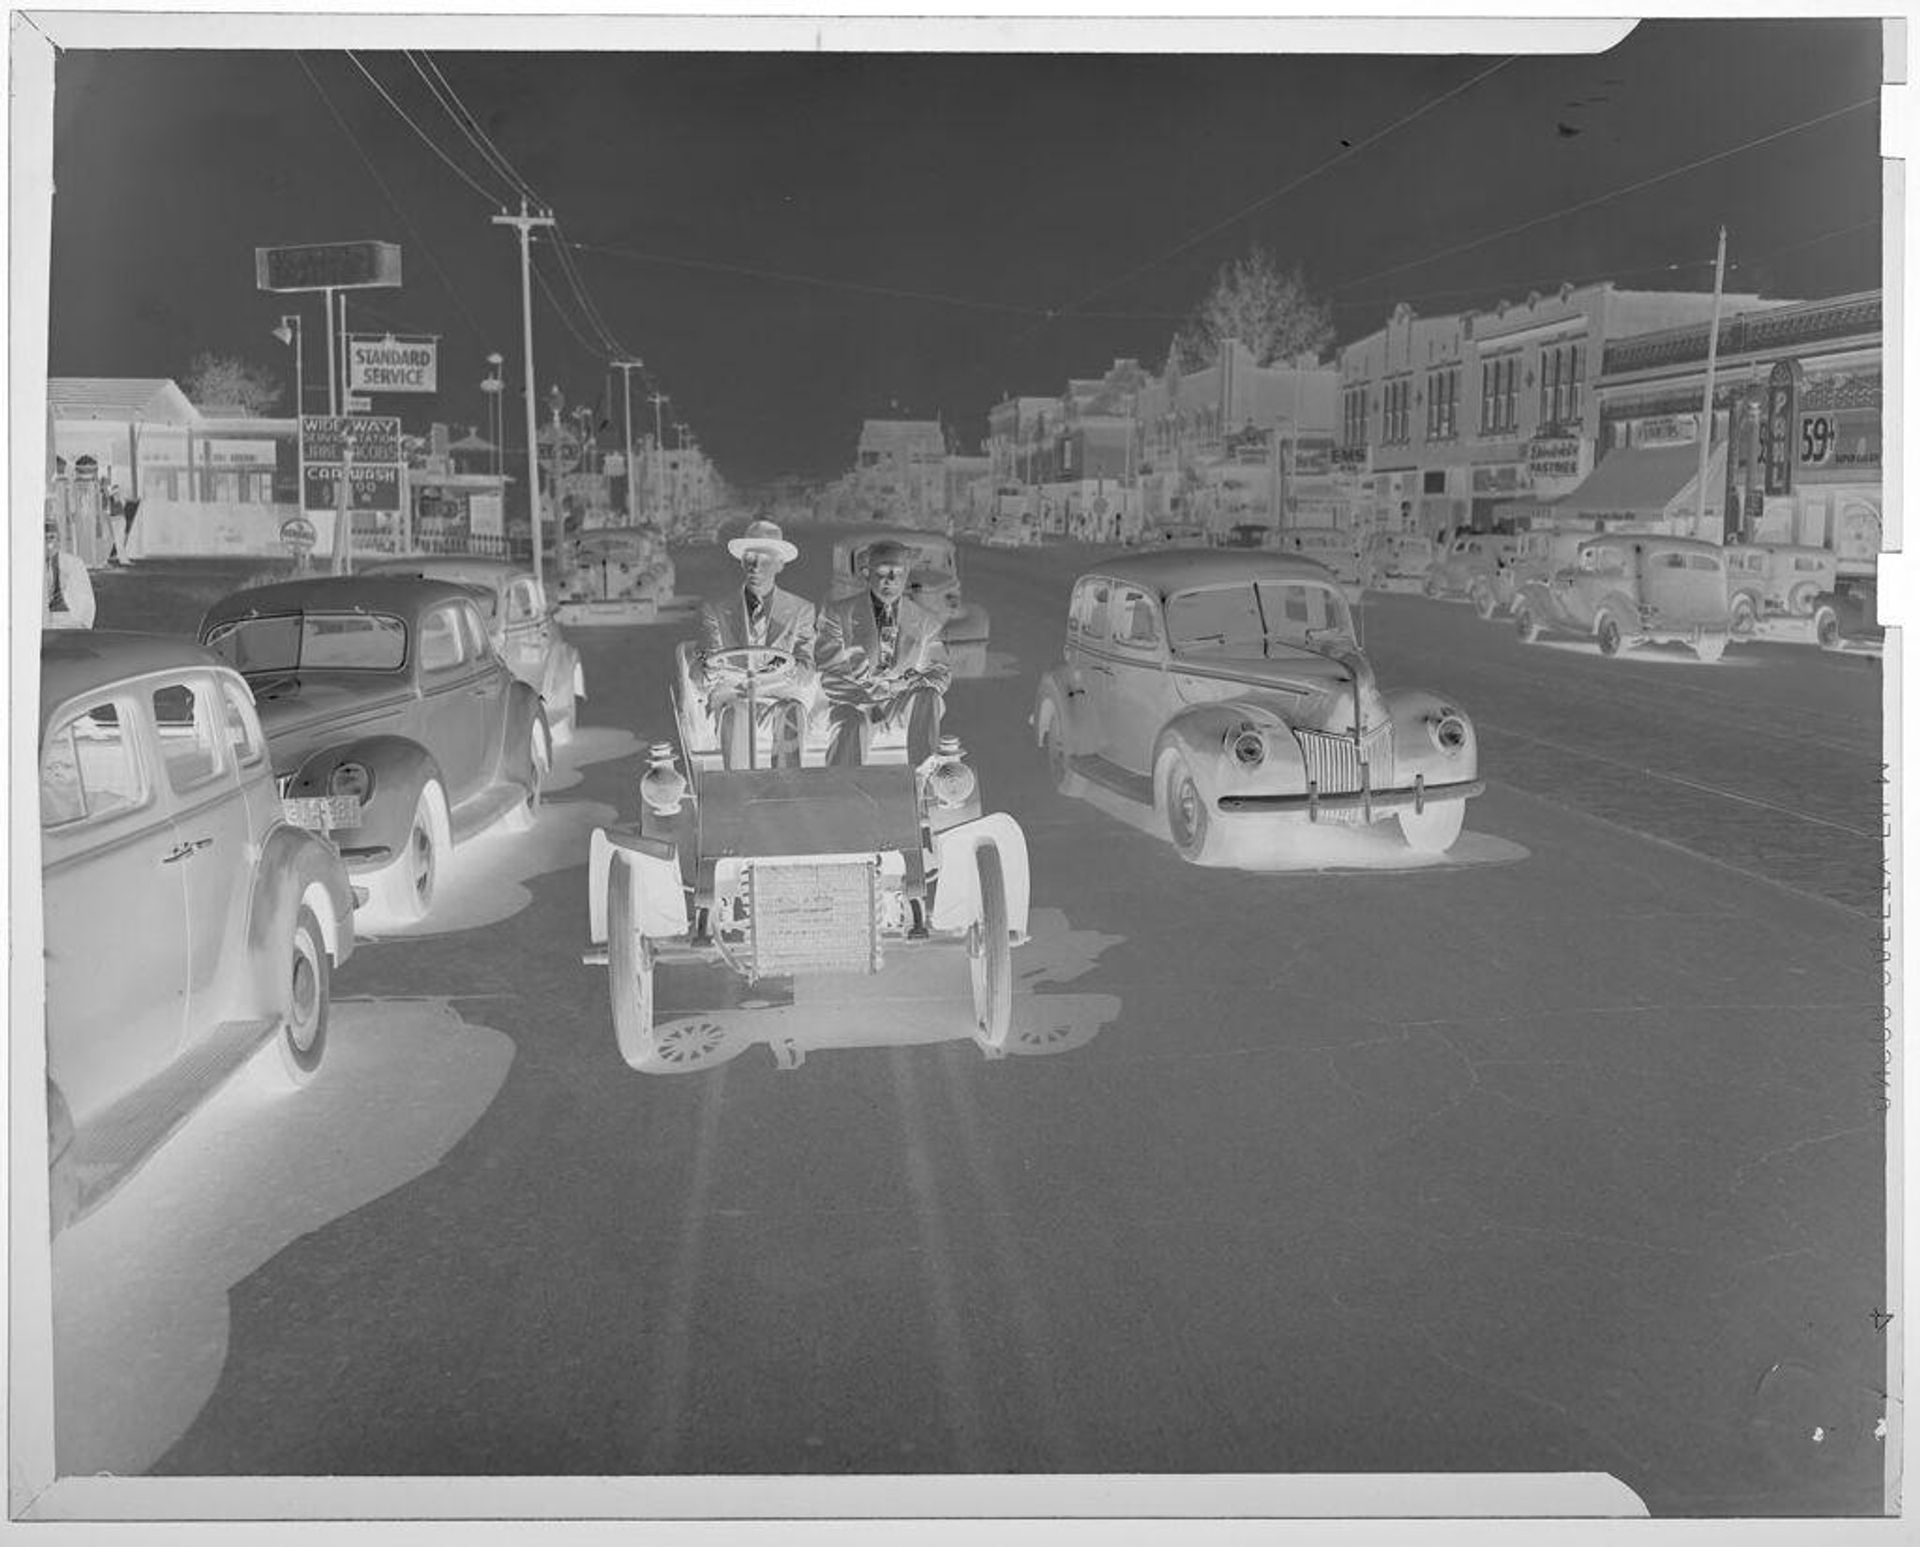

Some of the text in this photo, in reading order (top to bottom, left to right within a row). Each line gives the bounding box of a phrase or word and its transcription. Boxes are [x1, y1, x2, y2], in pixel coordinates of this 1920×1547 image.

[355, 347, 431, 367] STANDARD
[363, 367, 425, 386] SERVICE
[353, 418, 394, 433] WAY
[307, 467, 395, 482] CAR WASH
